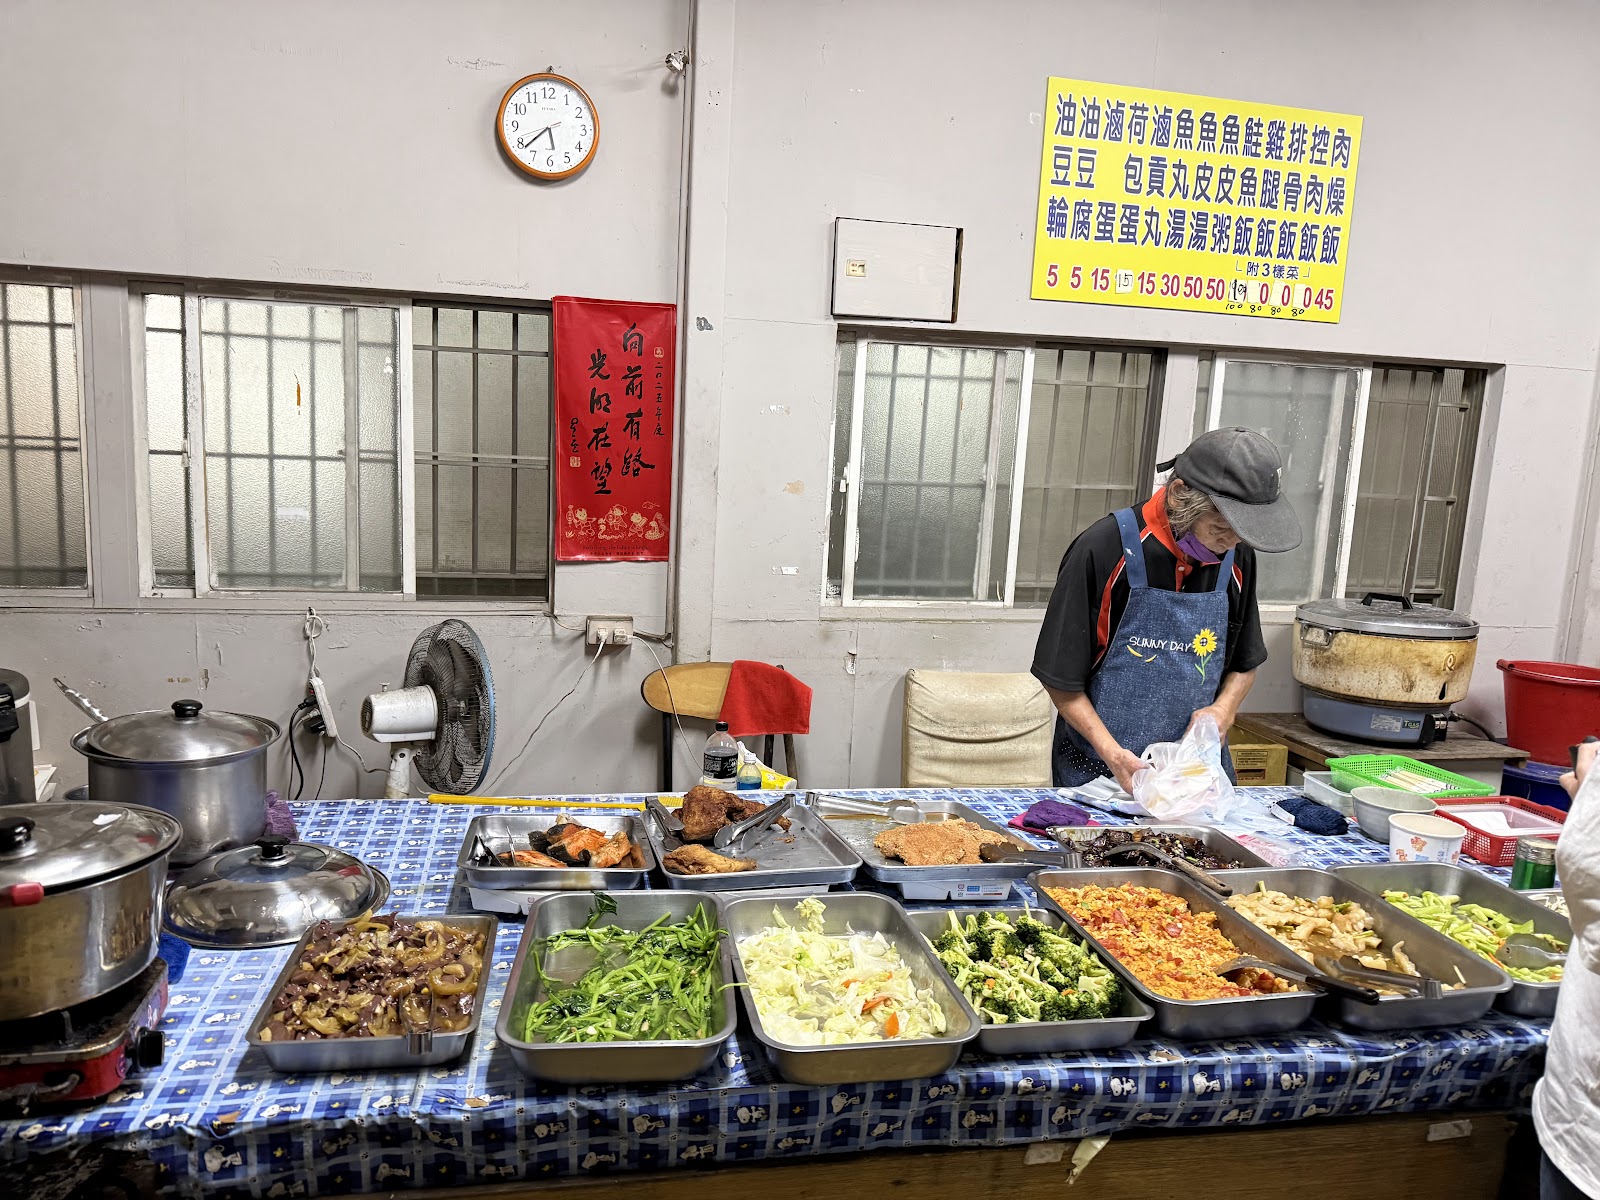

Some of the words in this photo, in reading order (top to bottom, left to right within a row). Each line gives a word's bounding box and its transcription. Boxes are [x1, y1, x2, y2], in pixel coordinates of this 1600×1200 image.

[514, 103, 526, 115] 10
[526, 92, 537, 103] 11
[542, 87, 556, 100] 12
[564, 94, 569, 106] 1
[575, 107, 582, 118] 2
[511, 121, 519, 132] 9
[517, 137, 524, 149] 8
[575, 141, 582, 152] 4
[580, 125, 587, 136] 3
[530, 150, 537, 162] 7
[547, 155, 553, 167] 6
[564, 152, 571, 163] 5
[1046, 93, 1077, 238] 油豆輪
[1070, 96, 1101, 241] 油豆腐
[1118, 102, 1149, 245] 荷包蛋
[1141, 105, 1173, 247] 滷貢丸
[1165, 109, 1194, 249] 魚丸湯
[1187, 112, 1217, 251] 魚皮湯
[1210, 114, 1240, 254] 魚皮粥
[1233, 117, 1263, 256] 鮭魚飯
[1255, 120, 1286, 259] 雞腿飯
[1277, 122, 1308, 261] 排骨飯
[1298, 124, 1330, 262] 控肉飯
[1320, 128, 1352, 265] 肉燥飯
[1046, 264, 1058, 287] 5
[1070, 266, 1081, 289] 5
[1091, 268, 1110, 291] 15
[1118, 273, 1133, 288] 15
[1138, 271, 1156, 295] 15
[1160, 274, 1180, 297] 30
[1183, 276, 1202, 299] 50
[1206, 278, 1225, 301] 50
[1314, 288, 1334, 310] 45
[1250, 304, 1262, 313] 80
[1271, 306, 1281, 315] 80
[1291, 308, 1305, 317] 80
[587, 349, 612, 495] 光明在望
[621, 322, 656, 478] 向前有路
[1129, 636, 1168, 650] SUNNY
[1170, 641, 1192, 652] DAY
